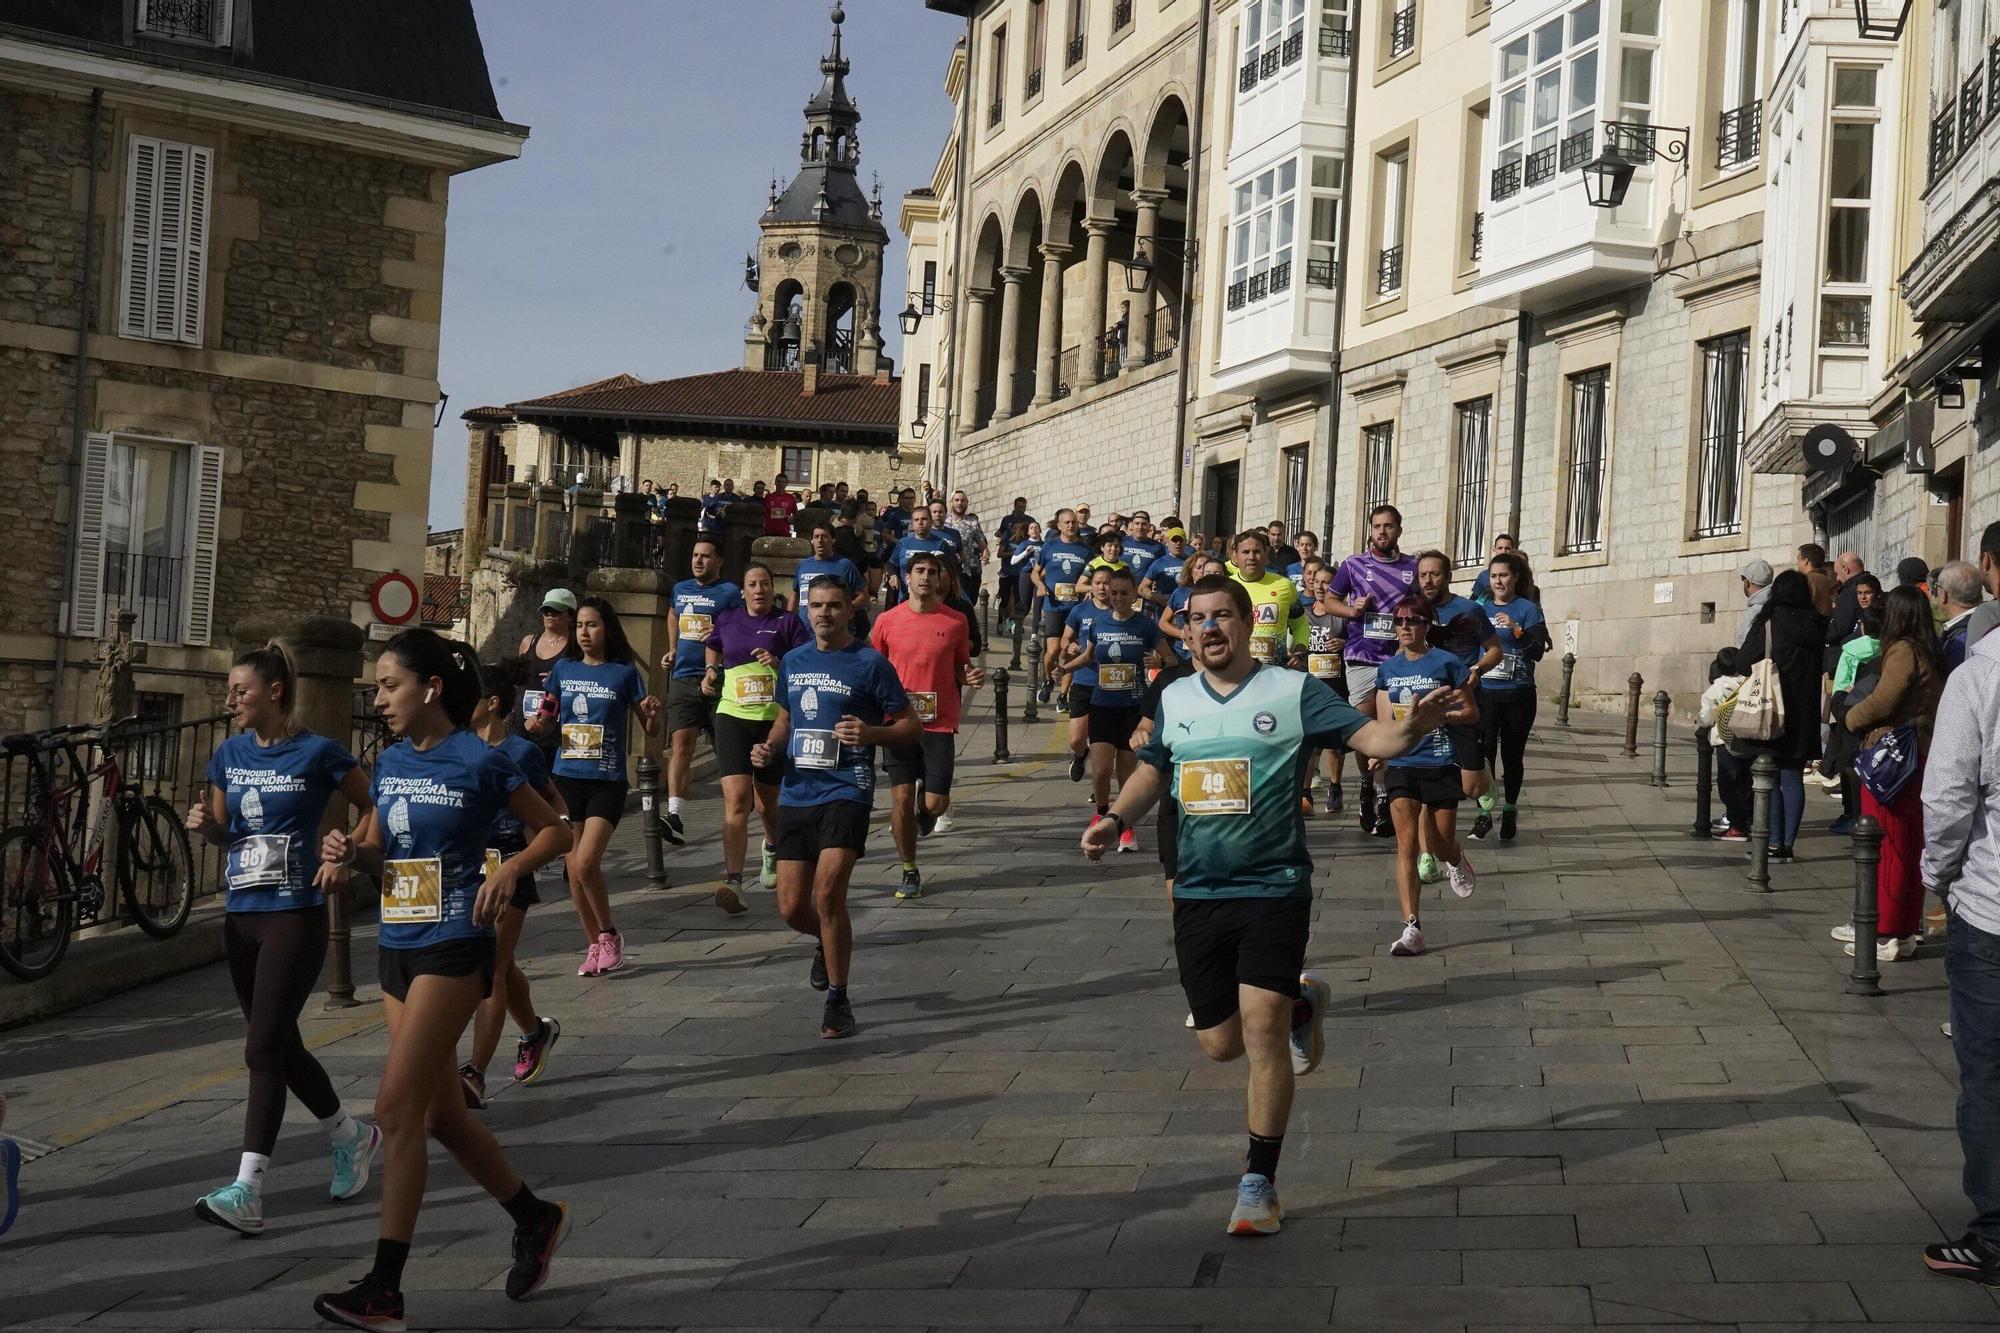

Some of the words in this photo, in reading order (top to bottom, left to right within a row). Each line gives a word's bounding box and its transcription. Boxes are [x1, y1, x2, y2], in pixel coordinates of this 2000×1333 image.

[1936, 494, 1943, 504] 2
[1261, 606, 1275, 620] A
[1372, 619, 1392, 630] 1057
[1109, 670, 1126, 680] 321
[566, 685, 609, 693] ALMENDRA
[794, 679, 842, 688] ALMENDRA
[817, 686, 851, 697] KONKISTA
[802, 739, 825, 754] 819
[232, 768, 276, 777] CONQUISTA
[231, 775, 292, 785] ALMENDRA
[384, 777, 432, 787] CONQUISTA
[1201, 773, 1225, 793] 49
[382, 784, 447, 796] ALMENDRA
[410, 795, 463, 808] KONKISTA
[240, 848, 268, 868] 987
[392, 875, 419, 899] 457
